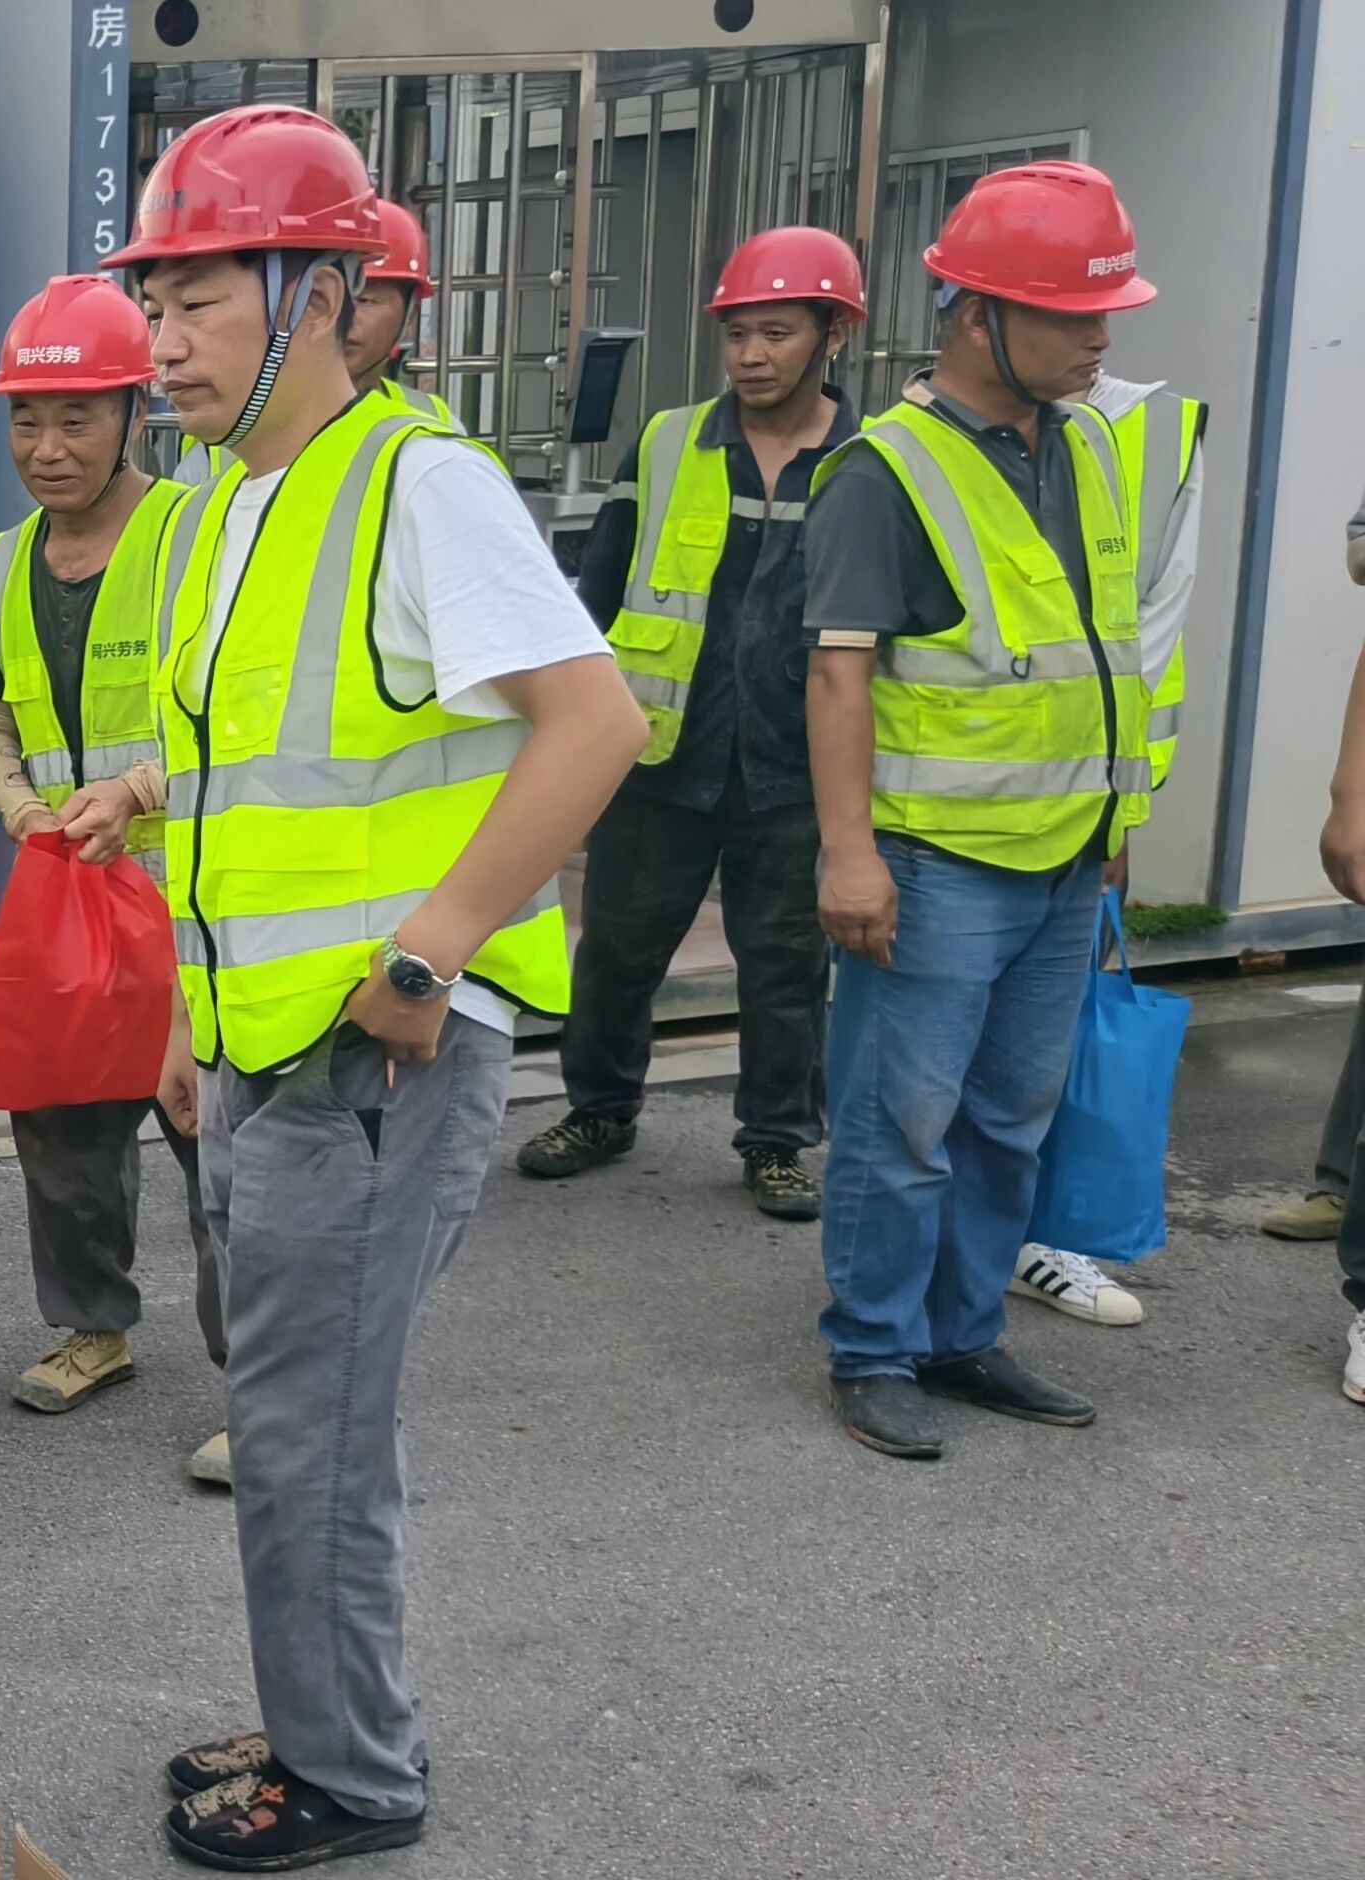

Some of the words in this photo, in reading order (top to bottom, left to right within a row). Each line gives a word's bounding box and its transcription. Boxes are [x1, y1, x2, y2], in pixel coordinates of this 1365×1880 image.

[89, 4, 126, 278] 房1735
[16, 345, 81, 366] 同兴劳务
[91, 639, 147, 660] 同兴劳务
